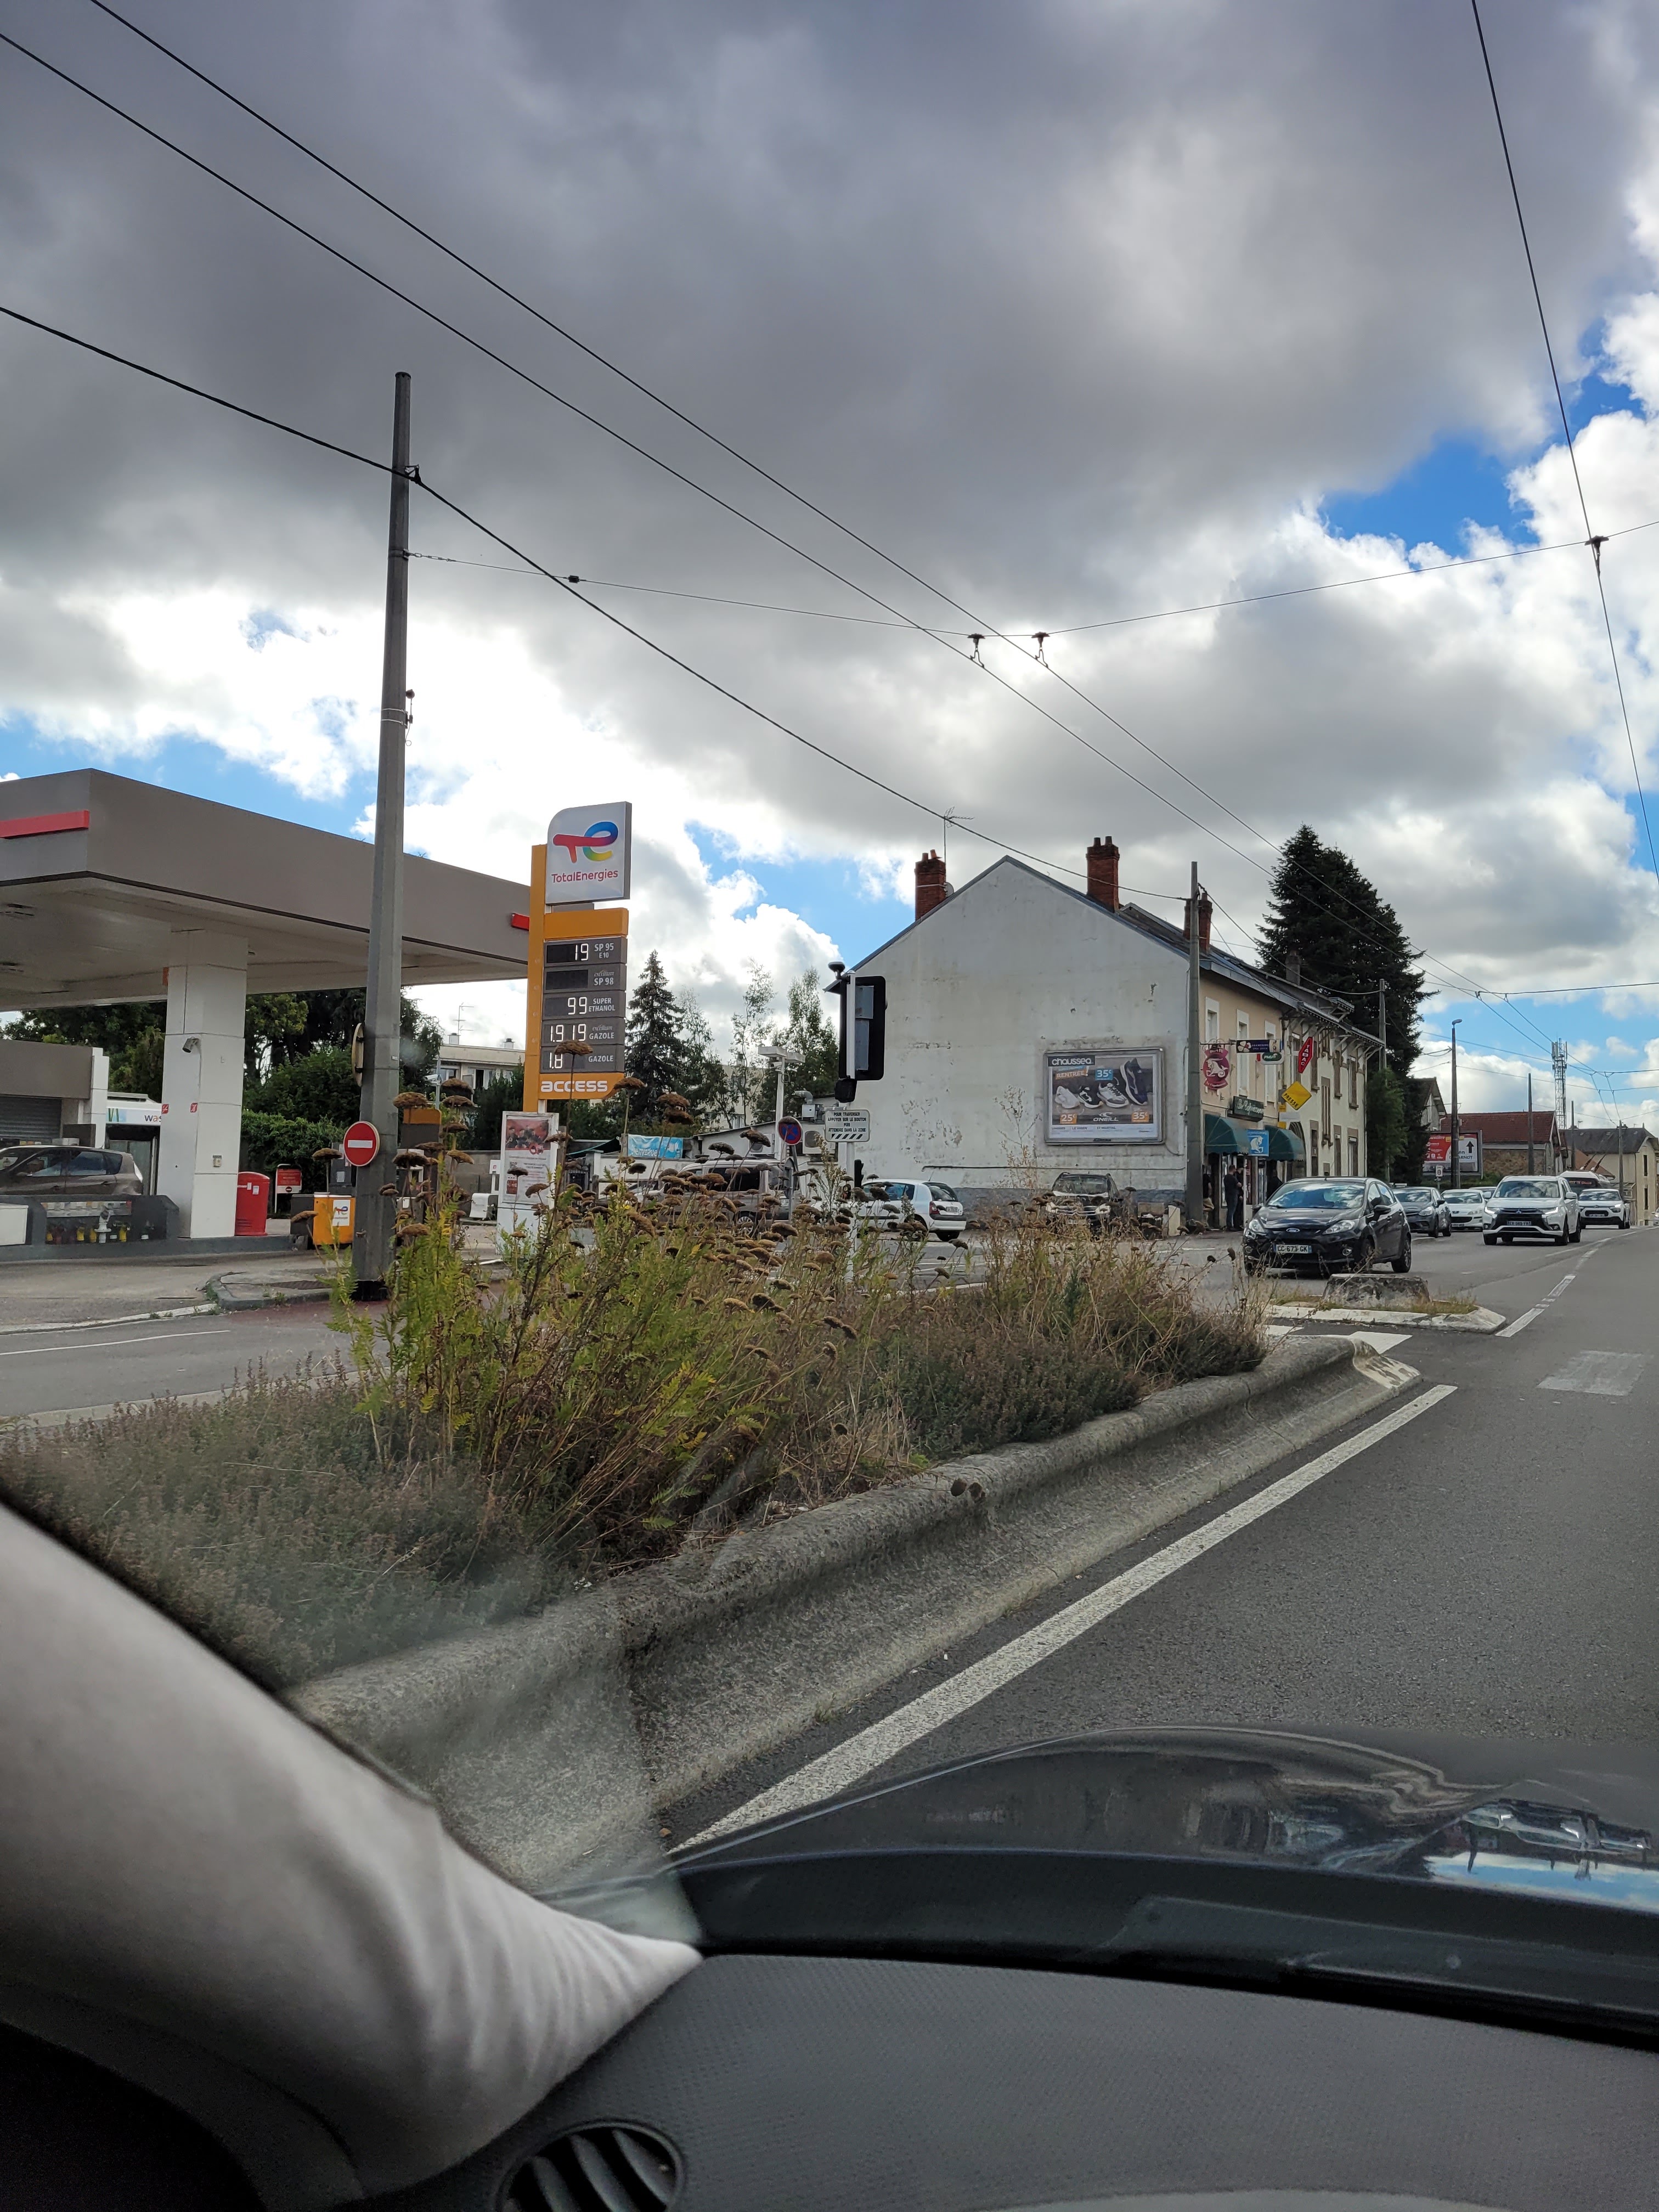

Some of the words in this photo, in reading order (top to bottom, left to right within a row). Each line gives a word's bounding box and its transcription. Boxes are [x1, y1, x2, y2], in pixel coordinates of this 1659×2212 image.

[551, 868, 618, 883] TotalEnergies
[594, 943, 603, 952] SP
[605, 943, 614, 951] 95
[588, 1005, 616, 1013] ETHANOL
[589, 1032, 615, 1040] GAZOLE
[1283, 1093, 1299, 1108] PRESSE
